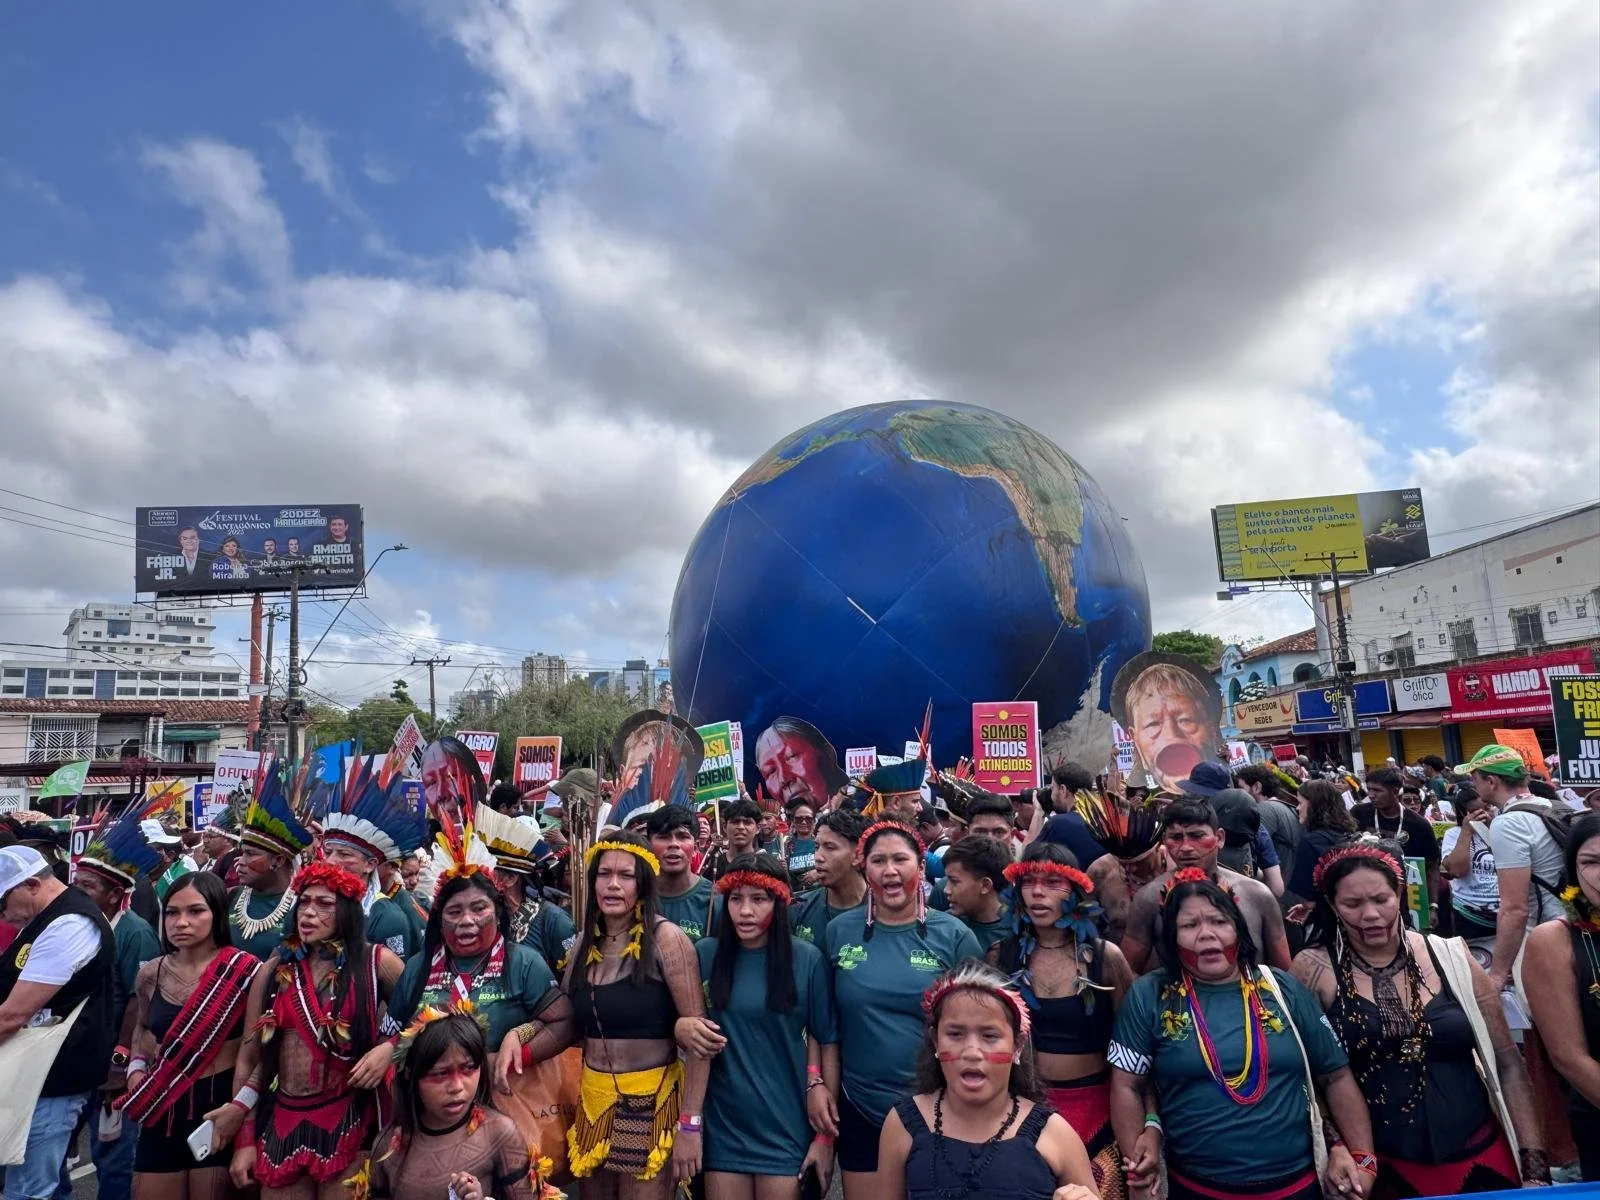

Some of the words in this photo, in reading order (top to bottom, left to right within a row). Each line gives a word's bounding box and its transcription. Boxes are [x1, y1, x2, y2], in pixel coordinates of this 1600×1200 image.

[217, 513, 261, 521] FESTIVAL
[1282, 508, 1310, 516] banco
[1312, 505, 1334, 513] mais
[216, 521, 271, 530] ANTAGÔNICO
[1245, 517, 1300, 527] sustentável
[1303, 515, 1315, 523] do
[1317, 511, 1355, 523] planeta
[1246, 526, 1267, 537] pela
[1269, 525, 1295, 534] sexta
[1297, 524, 1313, 532] vez
[313, 544, 351, 554] AMADO
[147, 554, 185, 568] FÁBIO
[155, 568, 176, 580] JR.
[1247, 702, 1277, 712] VENCEDOR
[1254, 716, 1273, 725] REDES
[981, 724, 1028, 740] SOMOS
[466, 734, 494, 751] AGRO
[982, 740, 1027, 758] TODOS
[519, 745, 556, 763] SOMOS
[1579, 740, 1600, 759] JU
[718, 754, 732, 767] DO
[849, 755, 874, 768] LULA
[979, 759, 1032, 771] ATINGIDOS
[218, 766, 226, 777] O
[227, 767, 258, 779] FUTUR
[520, 762, 553, 781] TODOS
